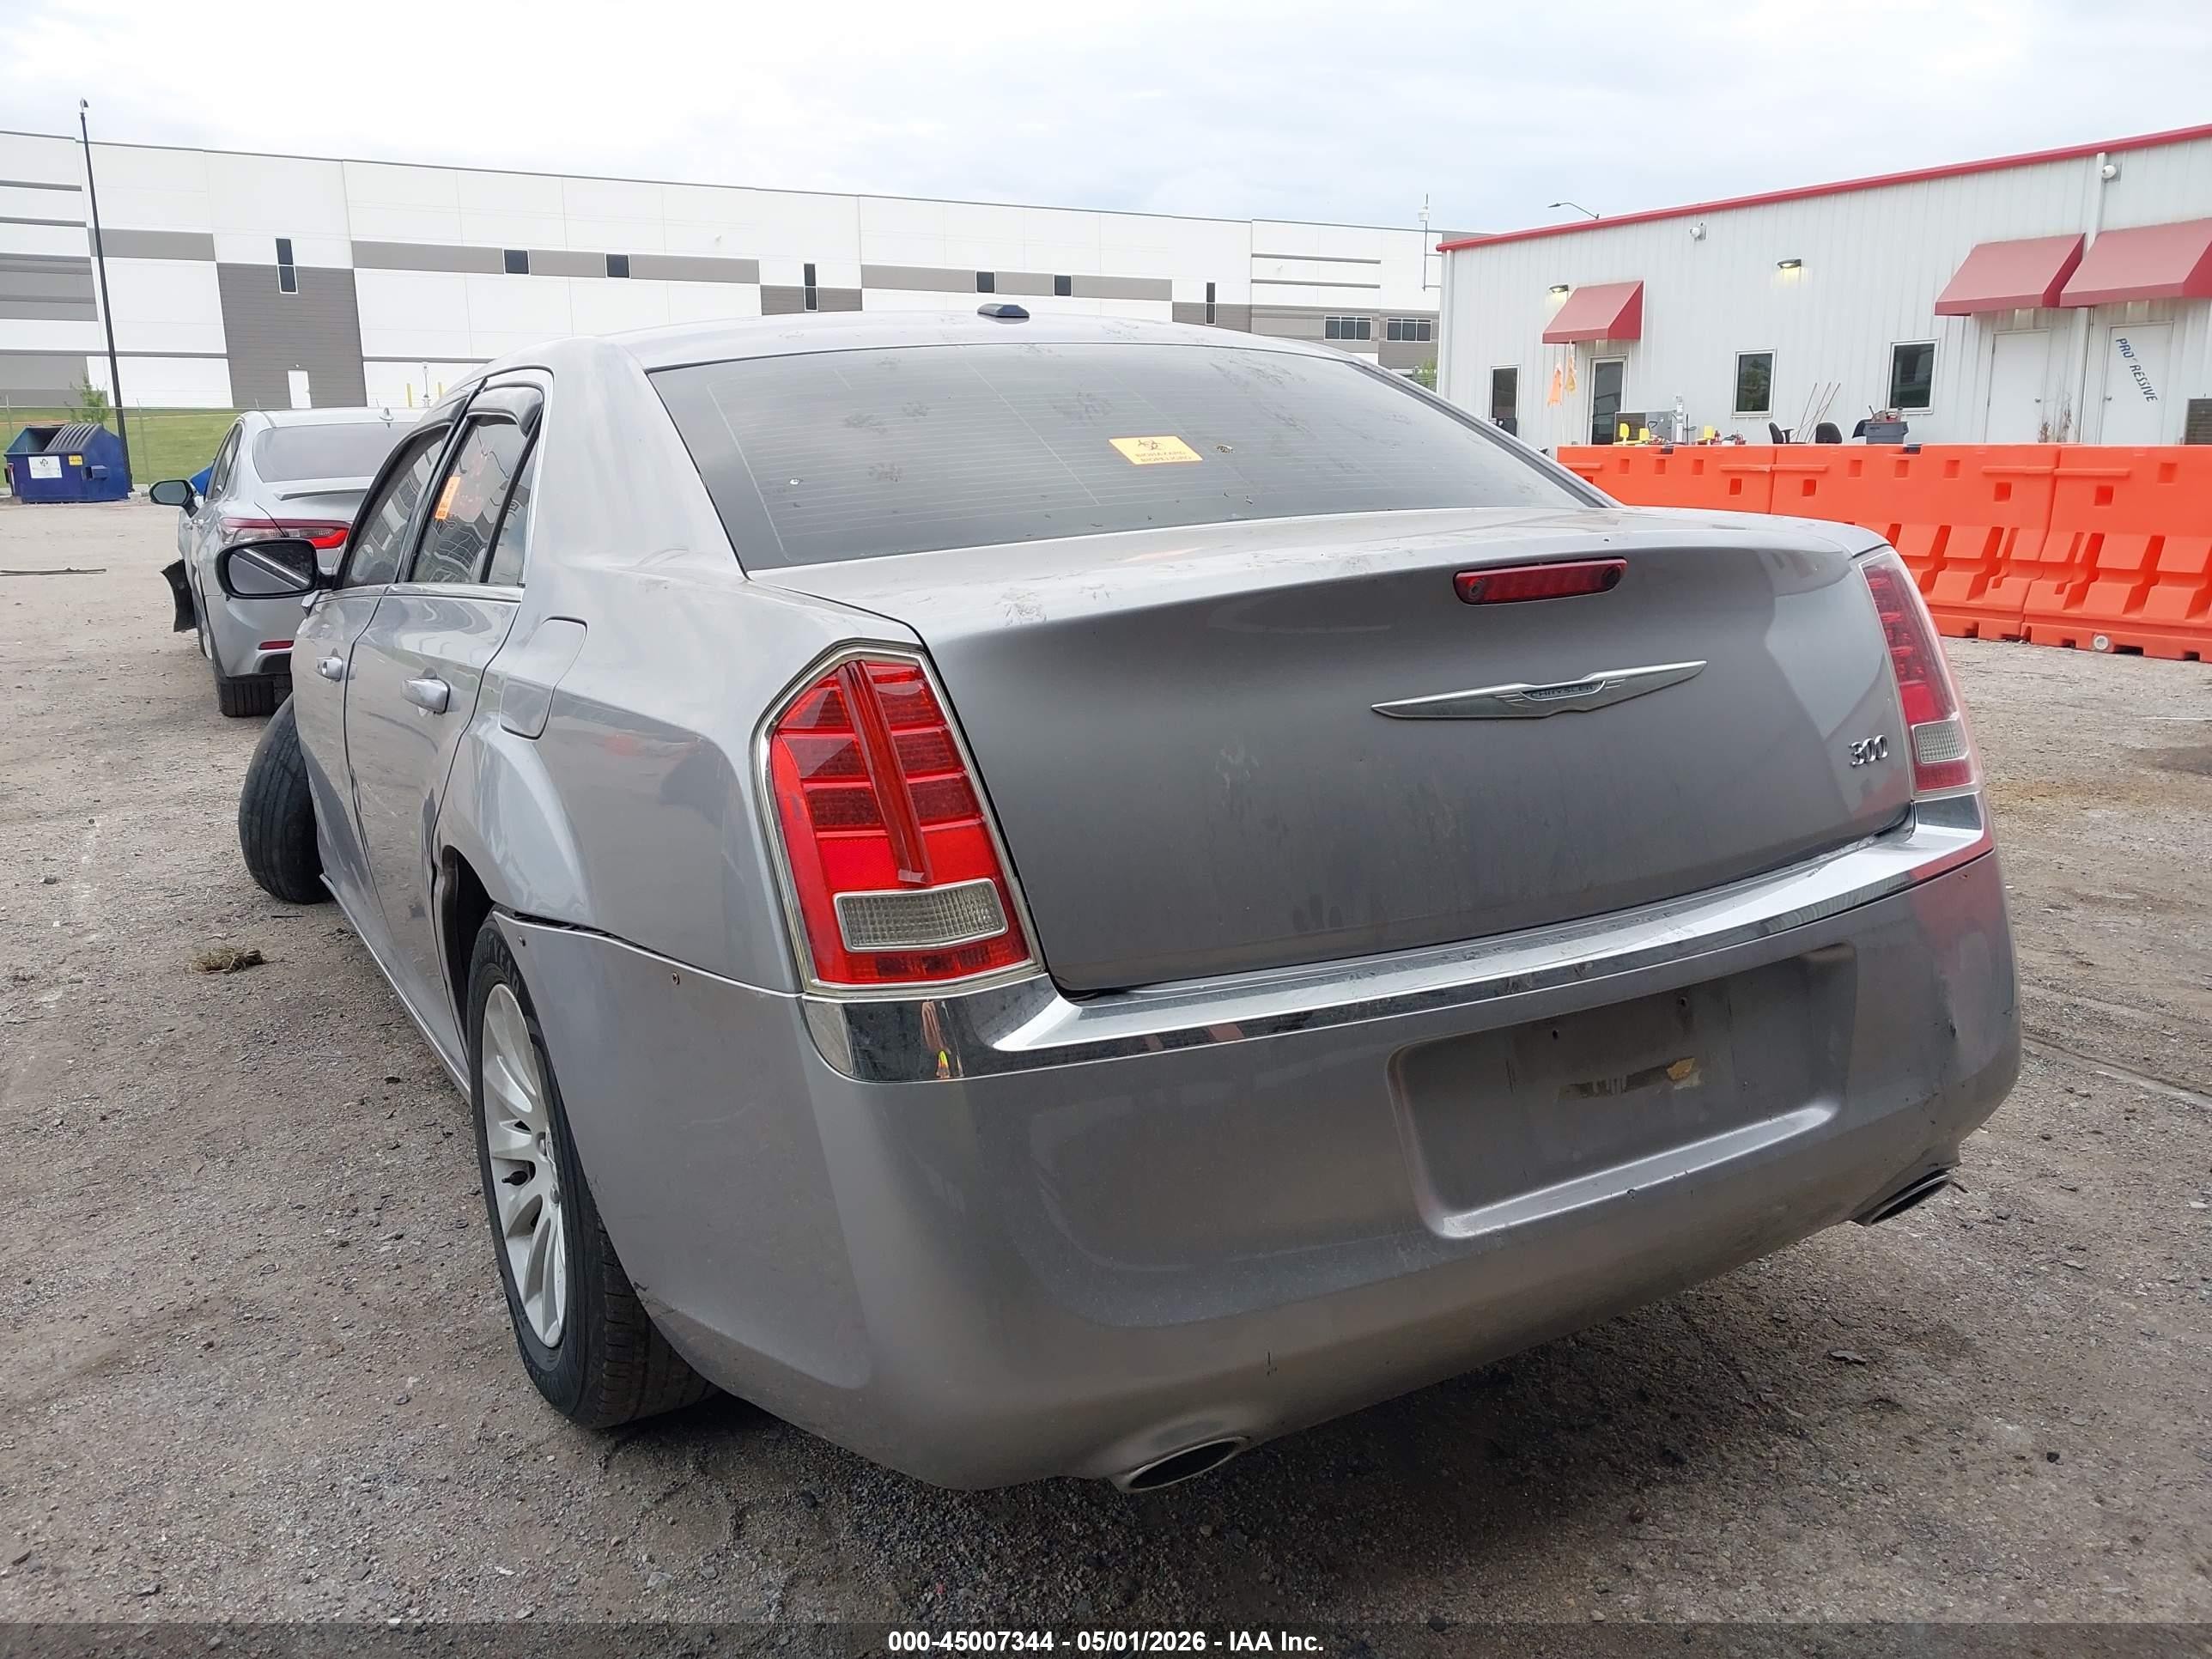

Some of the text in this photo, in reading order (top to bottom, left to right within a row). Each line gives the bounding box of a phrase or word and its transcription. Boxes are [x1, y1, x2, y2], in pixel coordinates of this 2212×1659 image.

[2115, 337, 2159, 403] PRORESSIVE
[1529, 685, 1595, 698] CHRYSLER
[1849, 734, 1888, 767] 300
